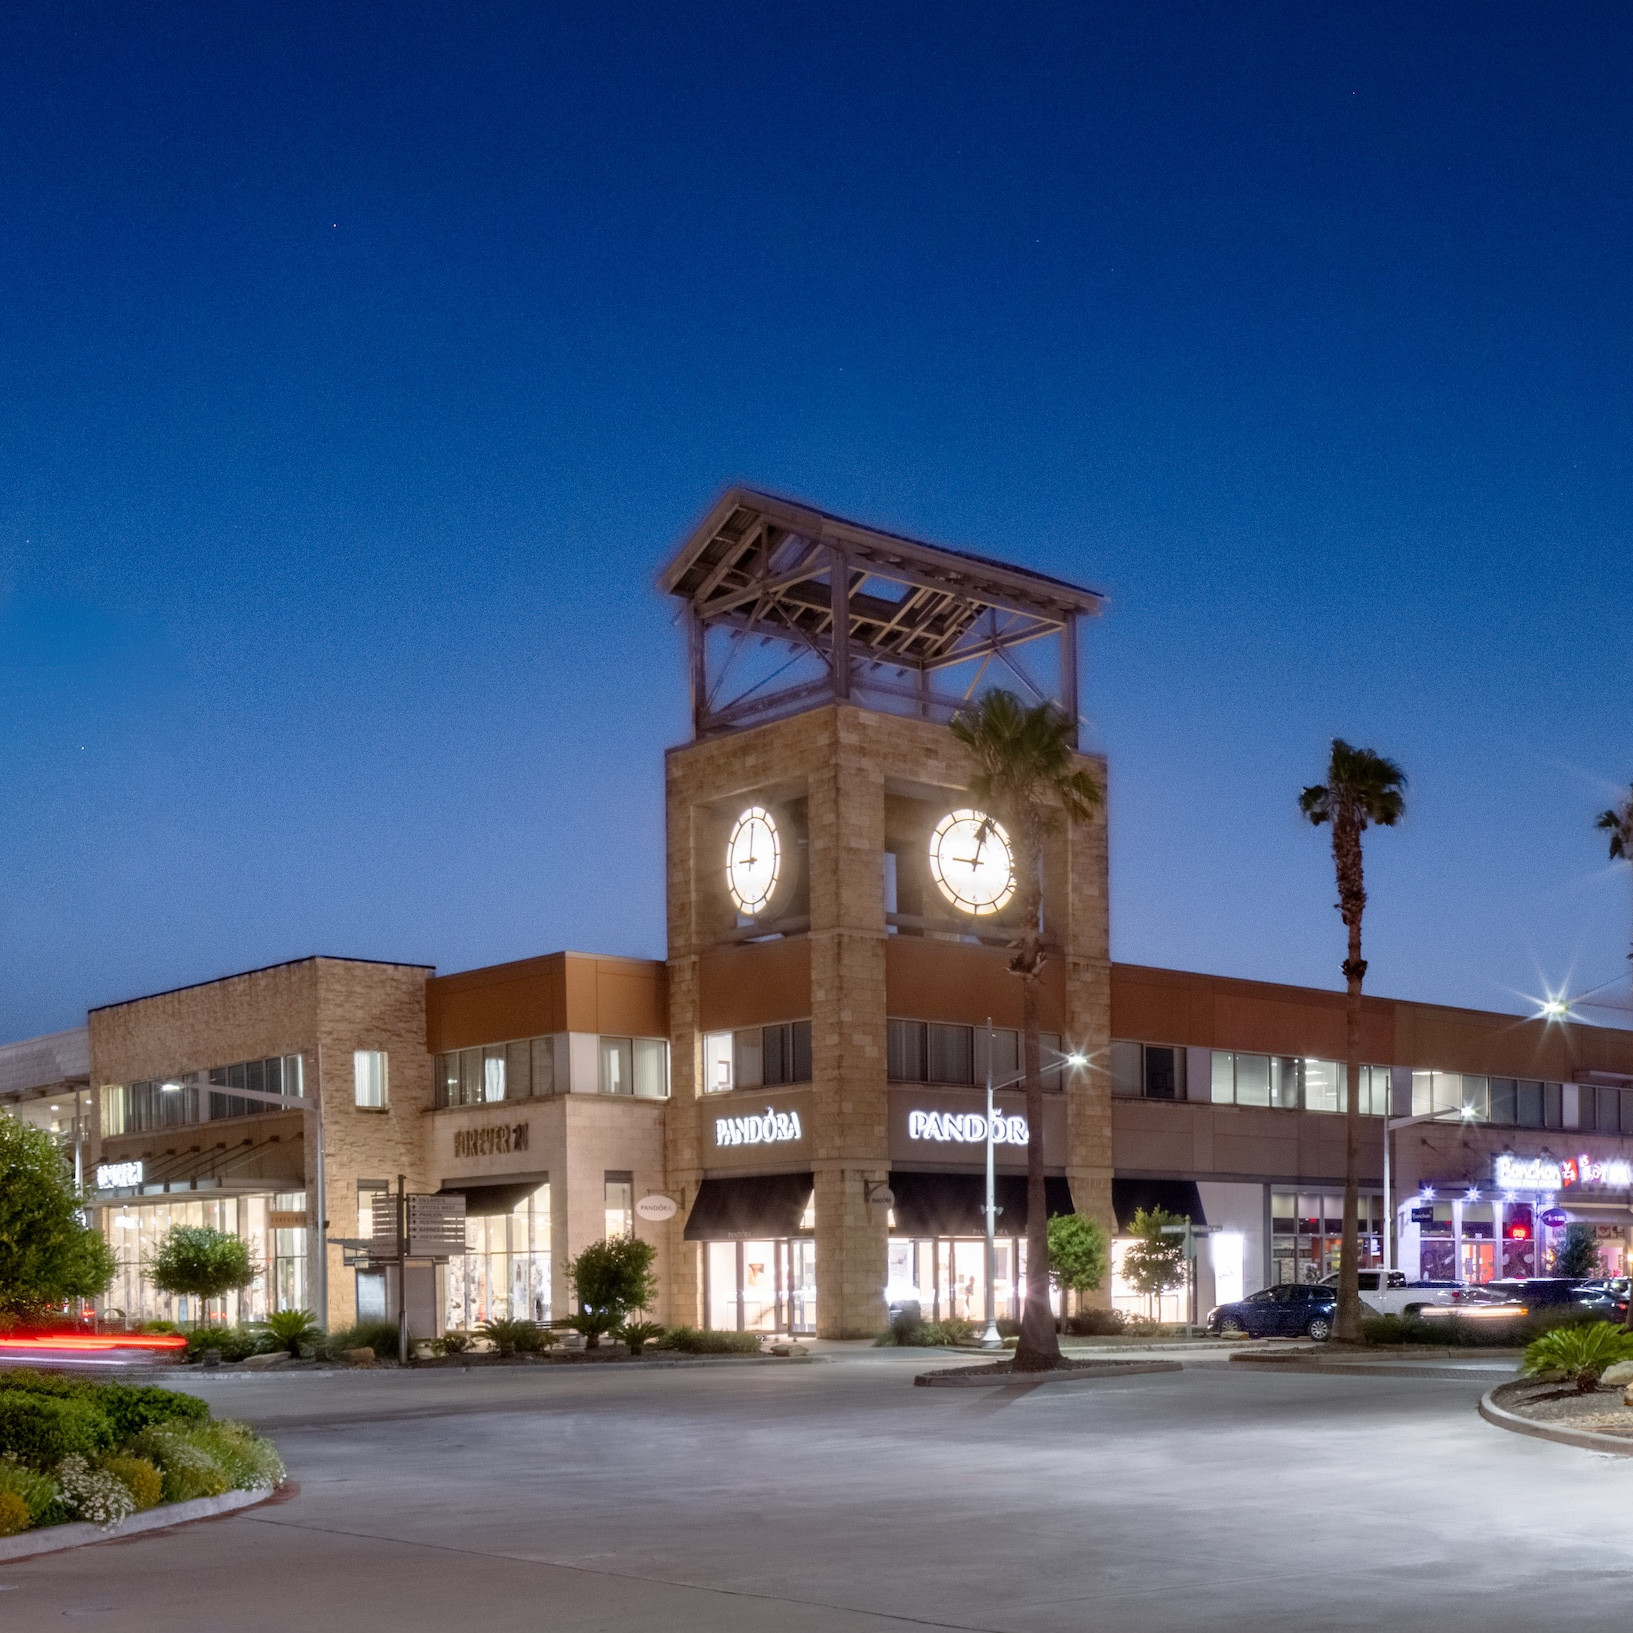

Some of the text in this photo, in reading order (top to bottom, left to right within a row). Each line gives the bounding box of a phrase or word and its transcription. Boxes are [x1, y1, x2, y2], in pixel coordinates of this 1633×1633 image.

[454, 1126, 511, 1158] FOREVER
[716, 1107, 802, 1146] PANDORA
[910, 1109, 1029, 1145] PANDOR
